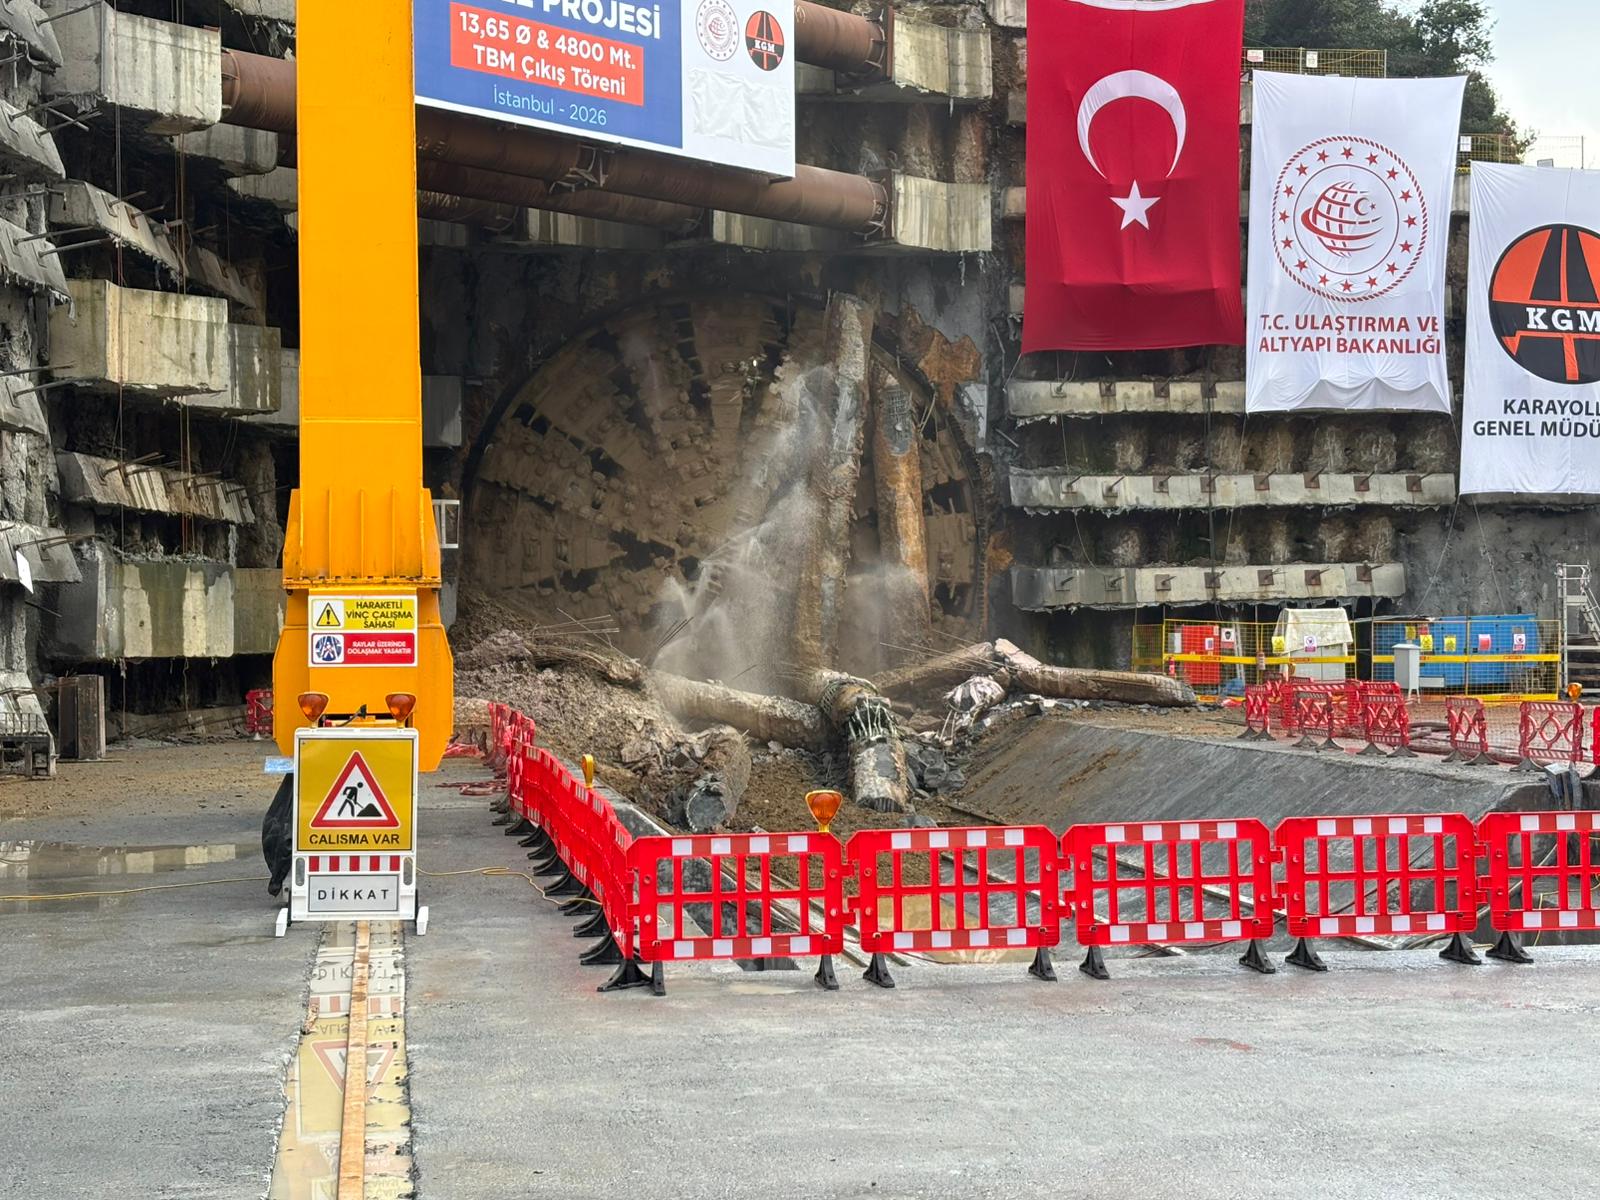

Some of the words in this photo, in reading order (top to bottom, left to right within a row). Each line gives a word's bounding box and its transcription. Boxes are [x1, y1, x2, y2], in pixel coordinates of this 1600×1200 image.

[460, 11, 510, 40] 13,65
[515, 24, 531, 44] Ø
[536, 30, 549, 49] &
[555, 35, 604, 62] 4800
[609, 46, 636, 70] Mt.
[754, 39, 775, 53] KGM
[473, 44, 516, 72] TBM
[521, 56, 566, 86] Çıkış
[571, 66, 626, 96] Töreni
[493, 84, 554, 115] İstanbul
[569, 104, 607, 126] 2026
[1260, 314, 1289, 330] T.C.
[1295, 314, 1410, 335] ULAŞTIRMA
[1417, 316, 1439, 332] VE
[1259, 336, 1331, 353] ALTYAPI
[1336, 335, 1440, 354] BAKANLIĞI
[1473, 420, 1535, 436] GENEL
[356, 599, 403, 609] HARAKETLİ
[346, 610, 370, 621] VİNÇ
[372, 610, 413, 621] ÇALIŞMA
[364, 620, 395, 629] SAHASI
[373, 834, 400, 844] VAR
[318, 887, 389, 900] DİKKAT
